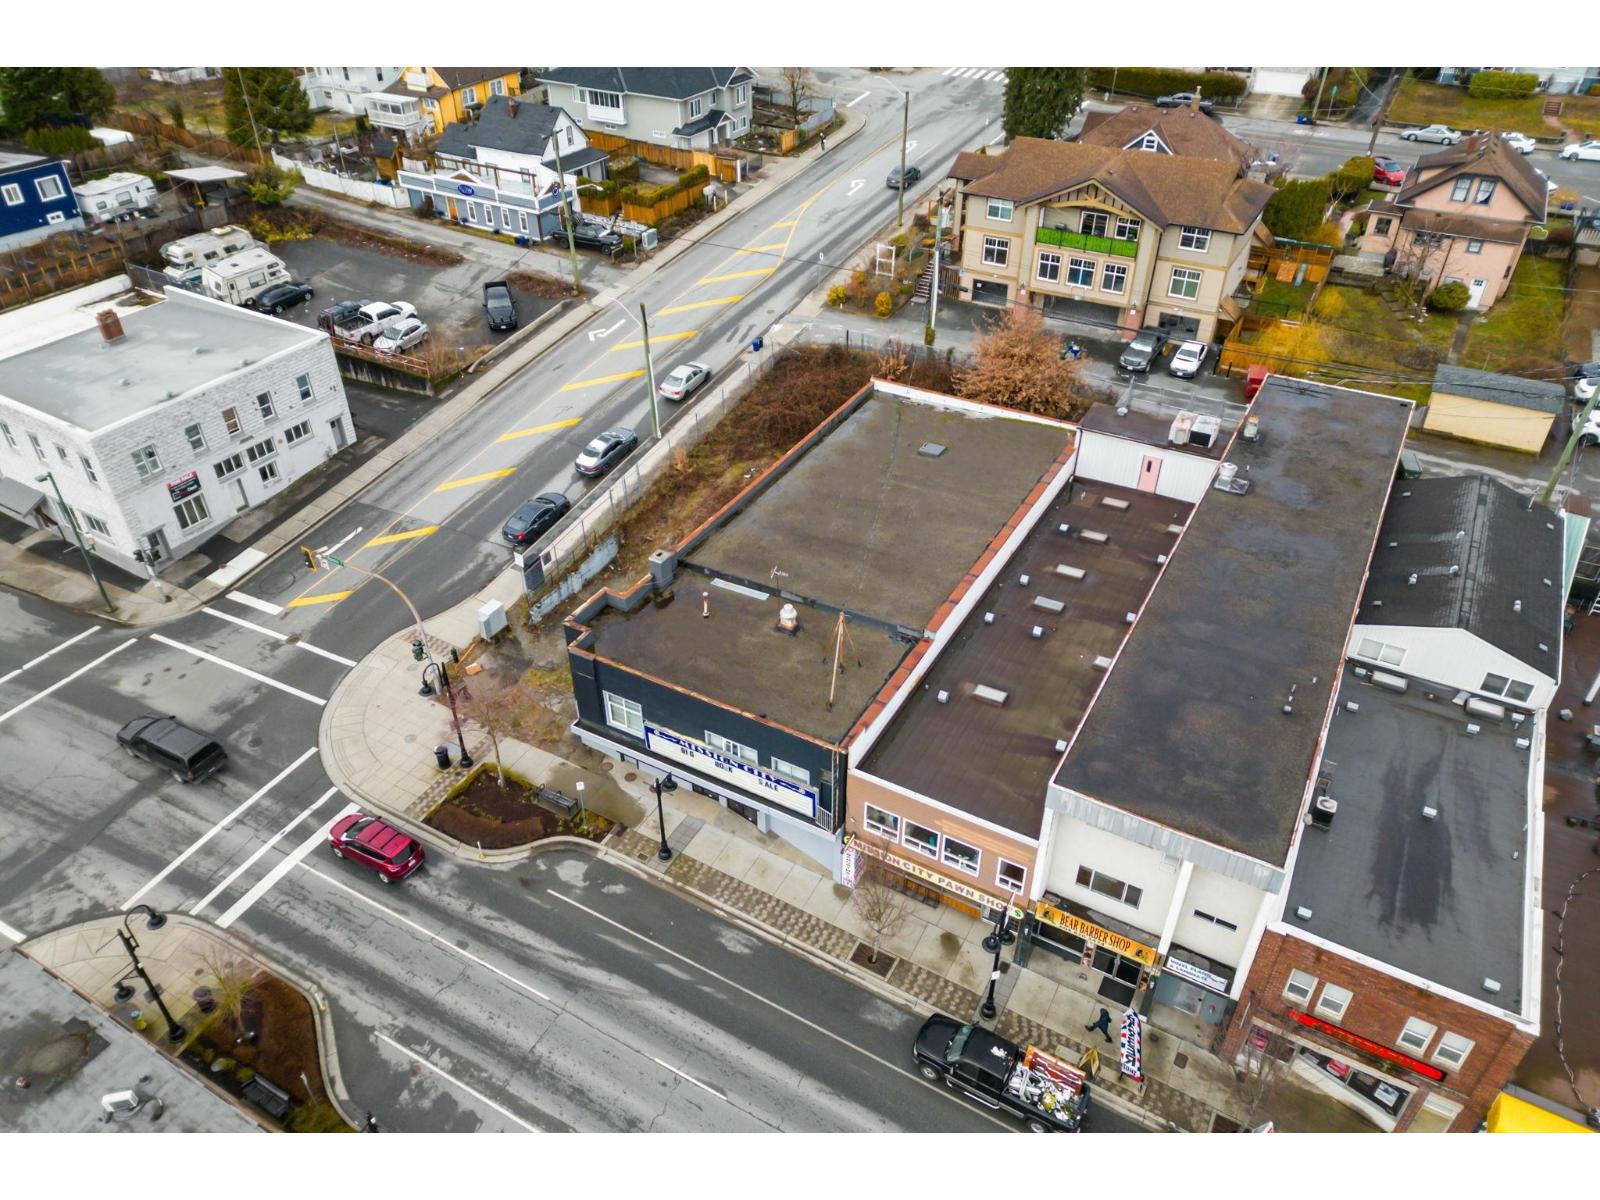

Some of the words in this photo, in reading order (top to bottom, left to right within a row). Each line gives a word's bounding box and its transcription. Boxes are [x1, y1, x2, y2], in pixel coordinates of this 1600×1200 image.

[853, 841, 901, 867] MISSION
[903, 861, 933, 880] CITY
[938, 876, 974, 897] PAWN
[1059, 912, 1079, 931] BEAR
[1079, 921, 1108, 944] BARBER
[1108, 933, 1131, 952] SHOP
